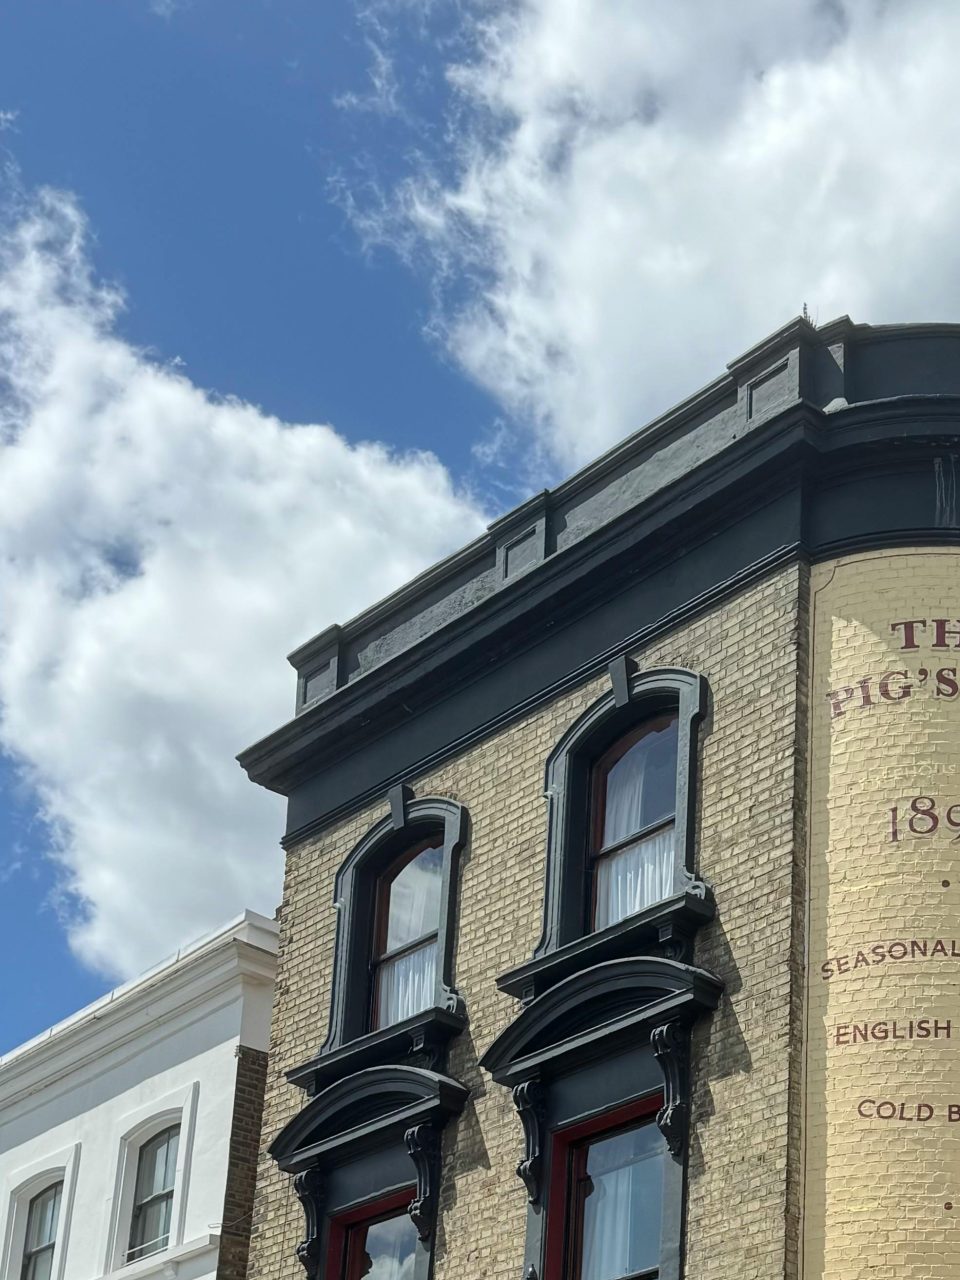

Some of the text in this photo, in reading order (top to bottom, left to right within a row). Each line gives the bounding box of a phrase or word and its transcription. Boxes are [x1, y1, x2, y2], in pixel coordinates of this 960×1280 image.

[825, 667, 959, 718] PIG'S
[835, 1019, 951, 1047] ENGLISH
[857, 1099, 934, 1122] COLD
